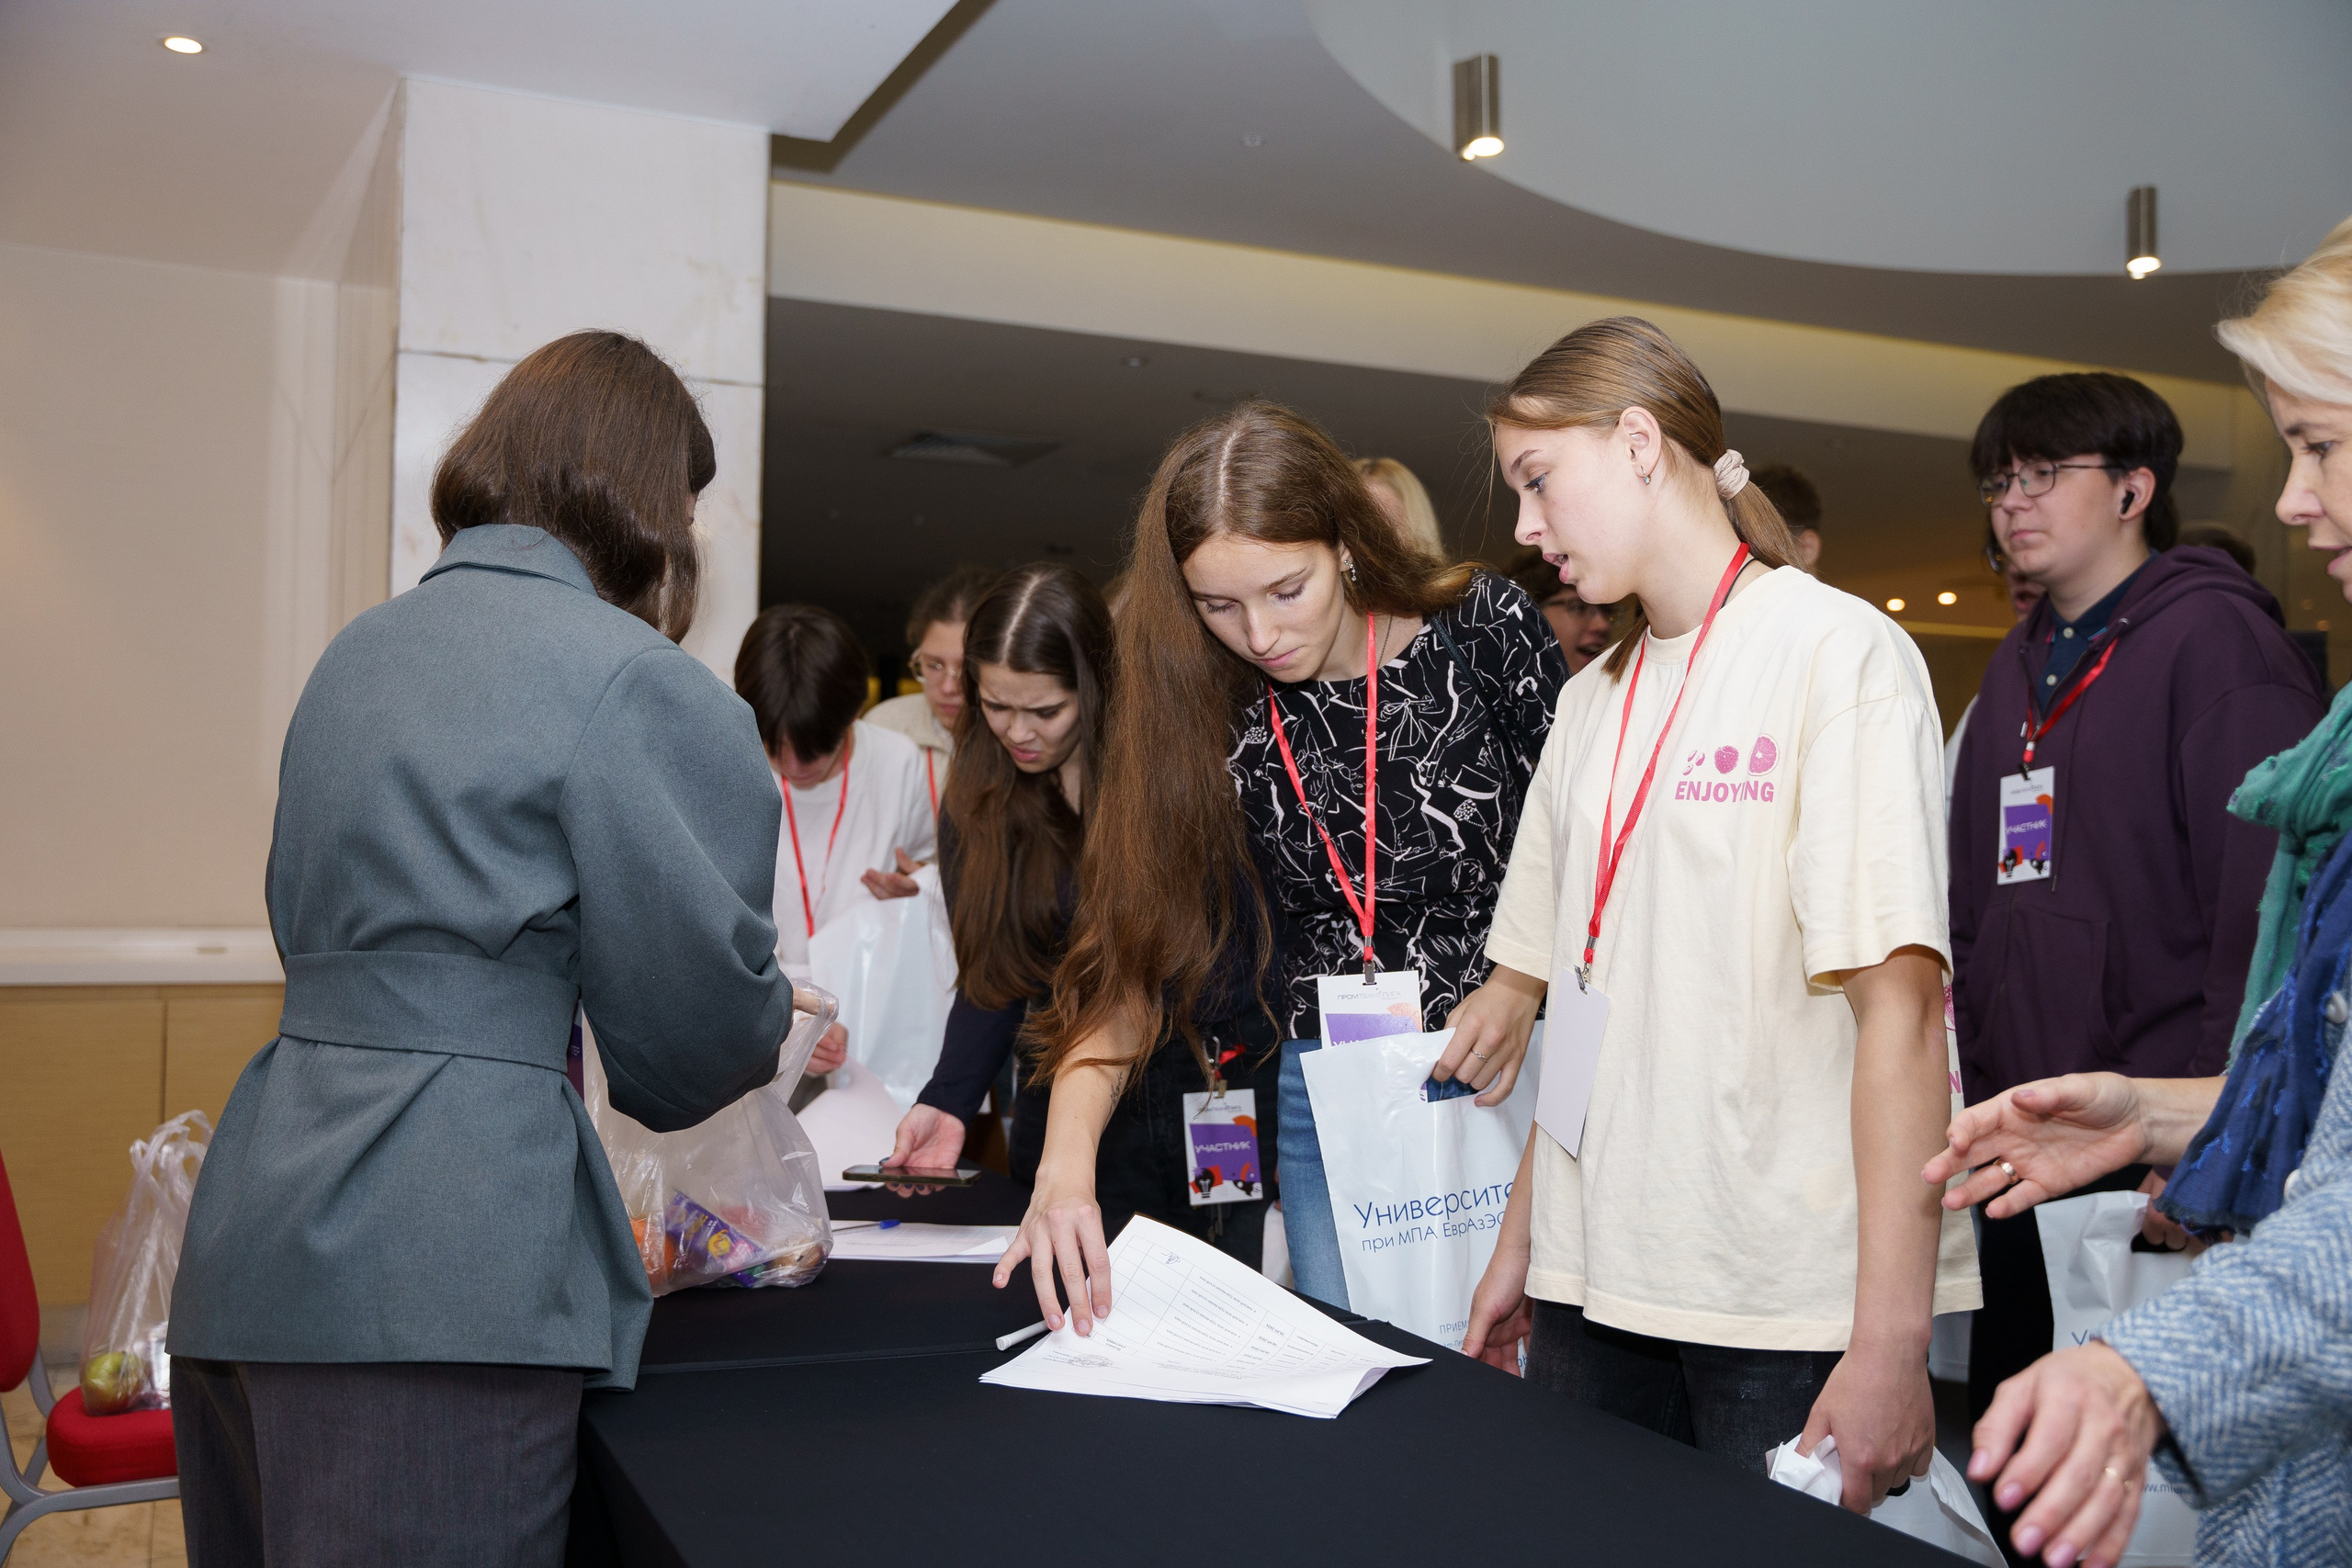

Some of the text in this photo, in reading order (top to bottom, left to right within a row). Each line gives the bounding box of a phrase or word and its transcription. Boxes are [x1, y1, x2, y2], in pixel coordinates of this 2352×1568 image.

[1675, 780, 1774, 803] ENJOYING
[1195, 1140, 1250, 1154] УЧАСТНИК
[1362, 1235, 1395, 1253] при
[1398, 1225, 1438, 1246] МПА
